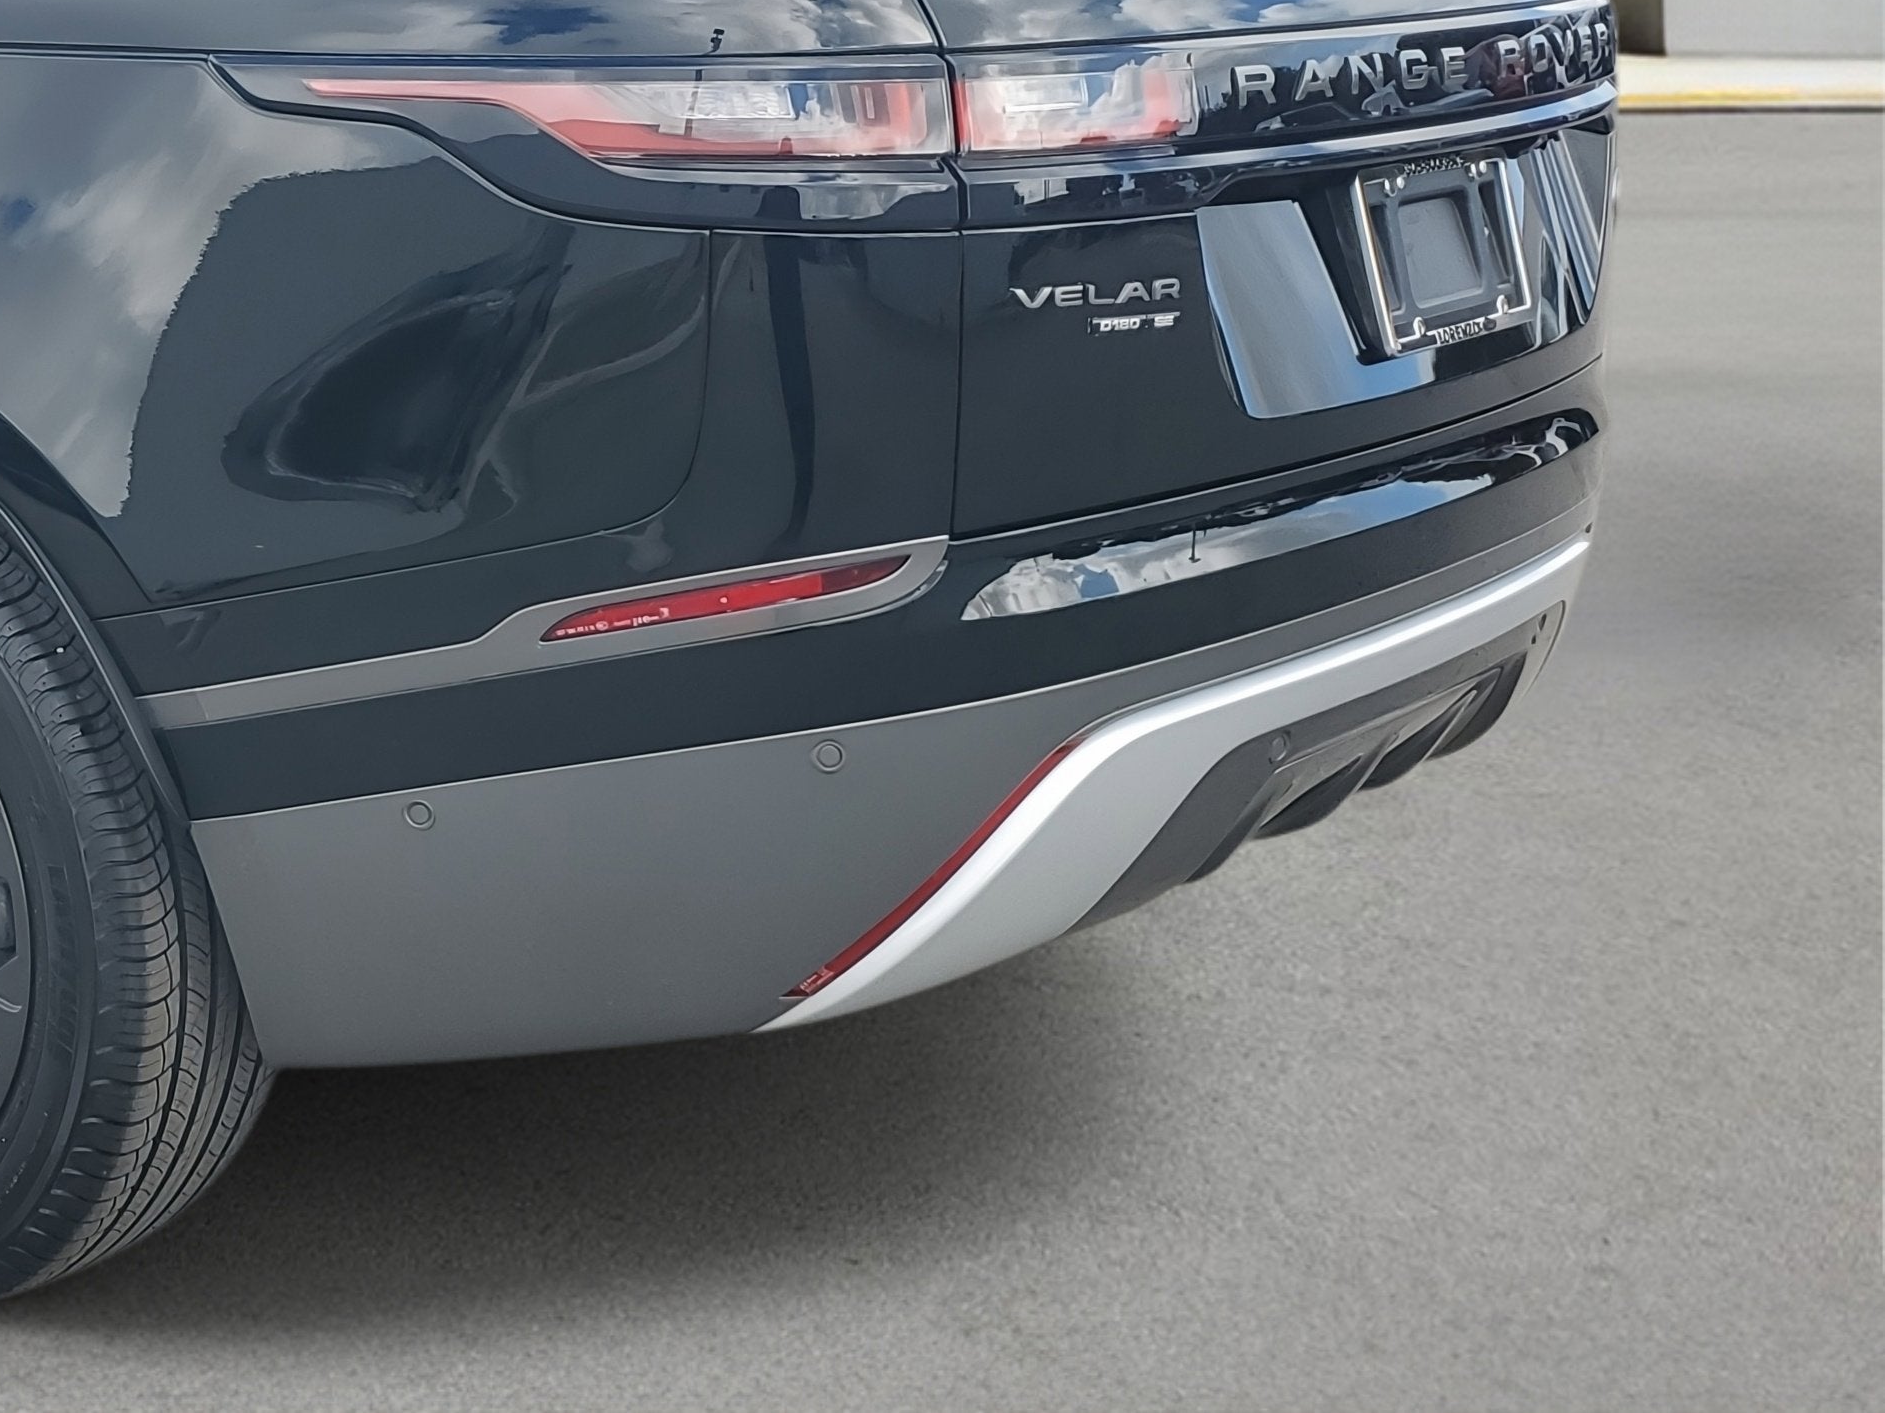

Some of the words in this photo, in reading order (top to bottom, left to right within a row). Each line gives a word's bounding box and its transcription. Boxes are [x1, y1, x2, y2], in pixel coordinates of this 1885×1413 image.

[1230, 45, 1469, 109] RANGE
[1497, 22, 1609, 79] ROVER
[1009, 277, 1181, 310] VELAR
